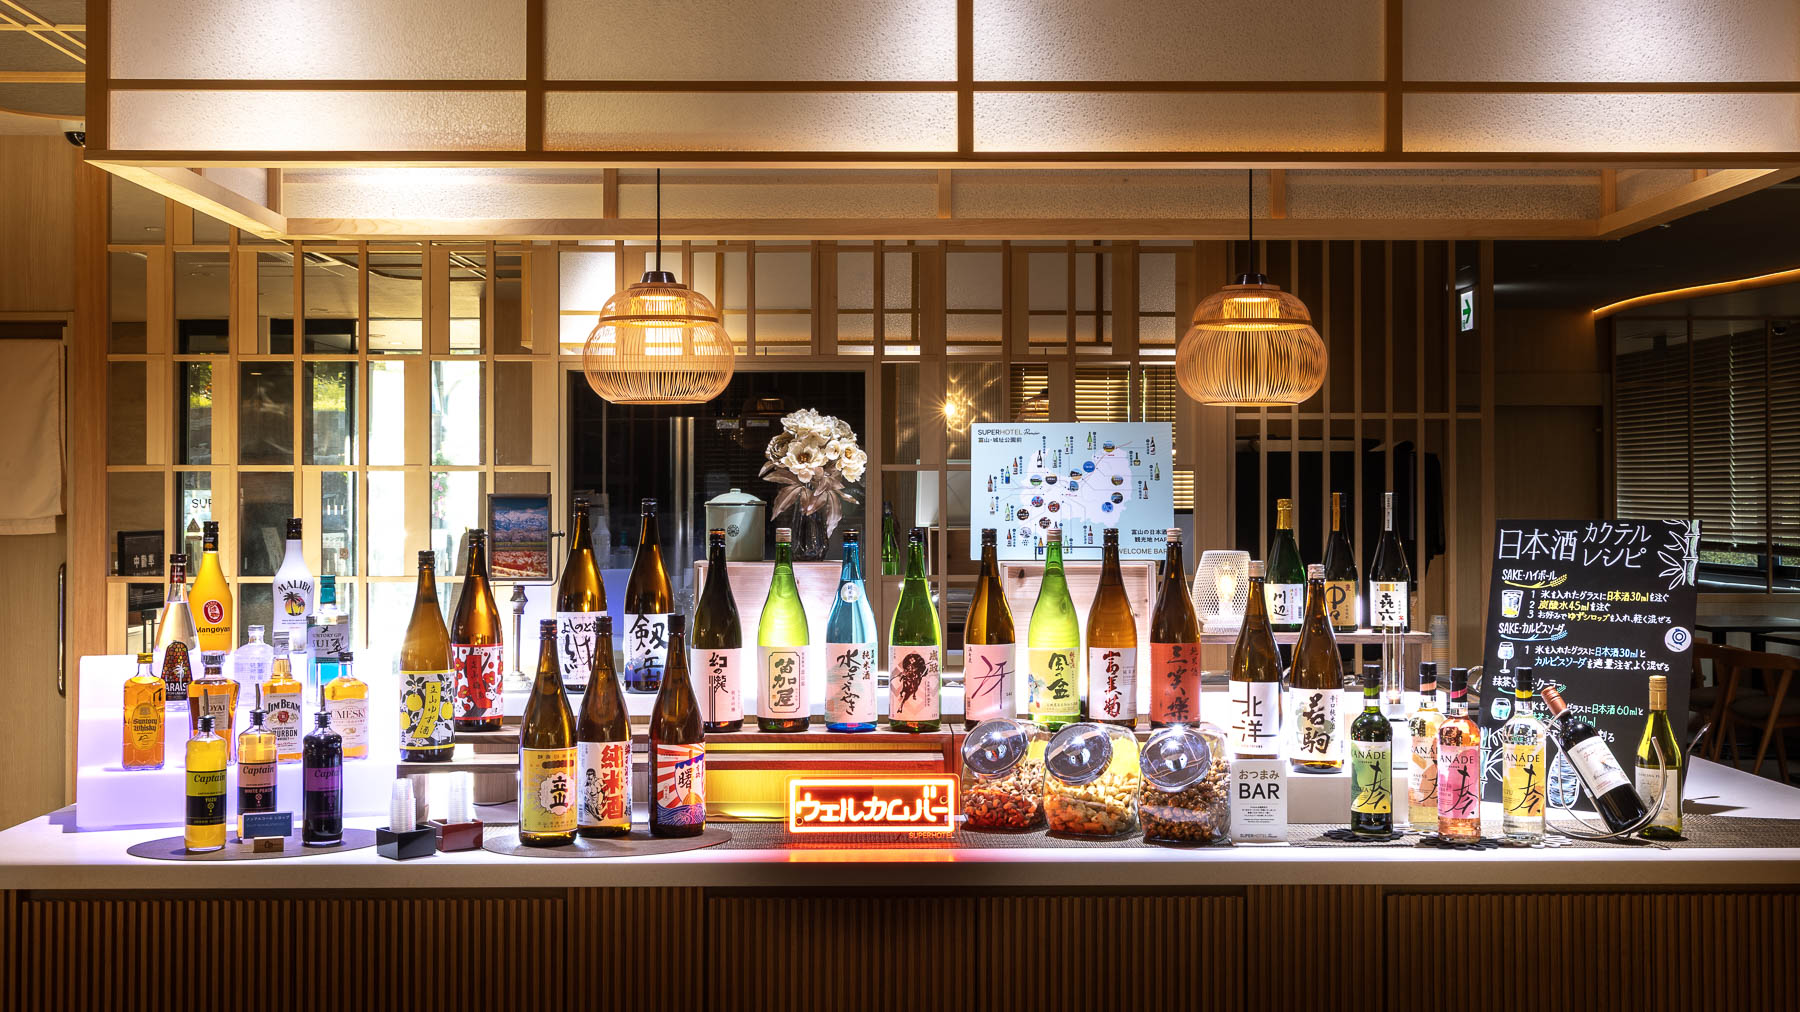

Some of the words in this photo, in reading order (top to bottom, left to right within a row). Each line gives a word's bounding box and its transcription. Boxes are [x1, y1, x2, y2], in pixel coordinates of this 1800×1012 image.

[977, 428, 1022, 436] SUPERHOTEL
[1498, 528, 1578, 562] 日本酒
[1582, 521, 1652, 546] カクテル
[1582, 546, 1648, 569] レシピ
[277, 579, 313, 595] MALIBU
[861, 650, 871, 681] 純米酒
[1102, 650, 1123, 719] 富美菊
[266, 702, 280, 715] JIM
[280, 698, 301, 713] BEAM
[1231, 684, 1268, 743] 北洋
[1504, 752, 1541, 763] ANÁDE
[242, 765, 275, 777] Captain
[600, 744, 624, 820] 純米酒
[1238, 769, 1280, 780] おつまみ
[549, 775, 569, 810] 立山
[1239, 782, 1280, 800] BAR
[796, 785, 949, 823] ウェルカムバー
